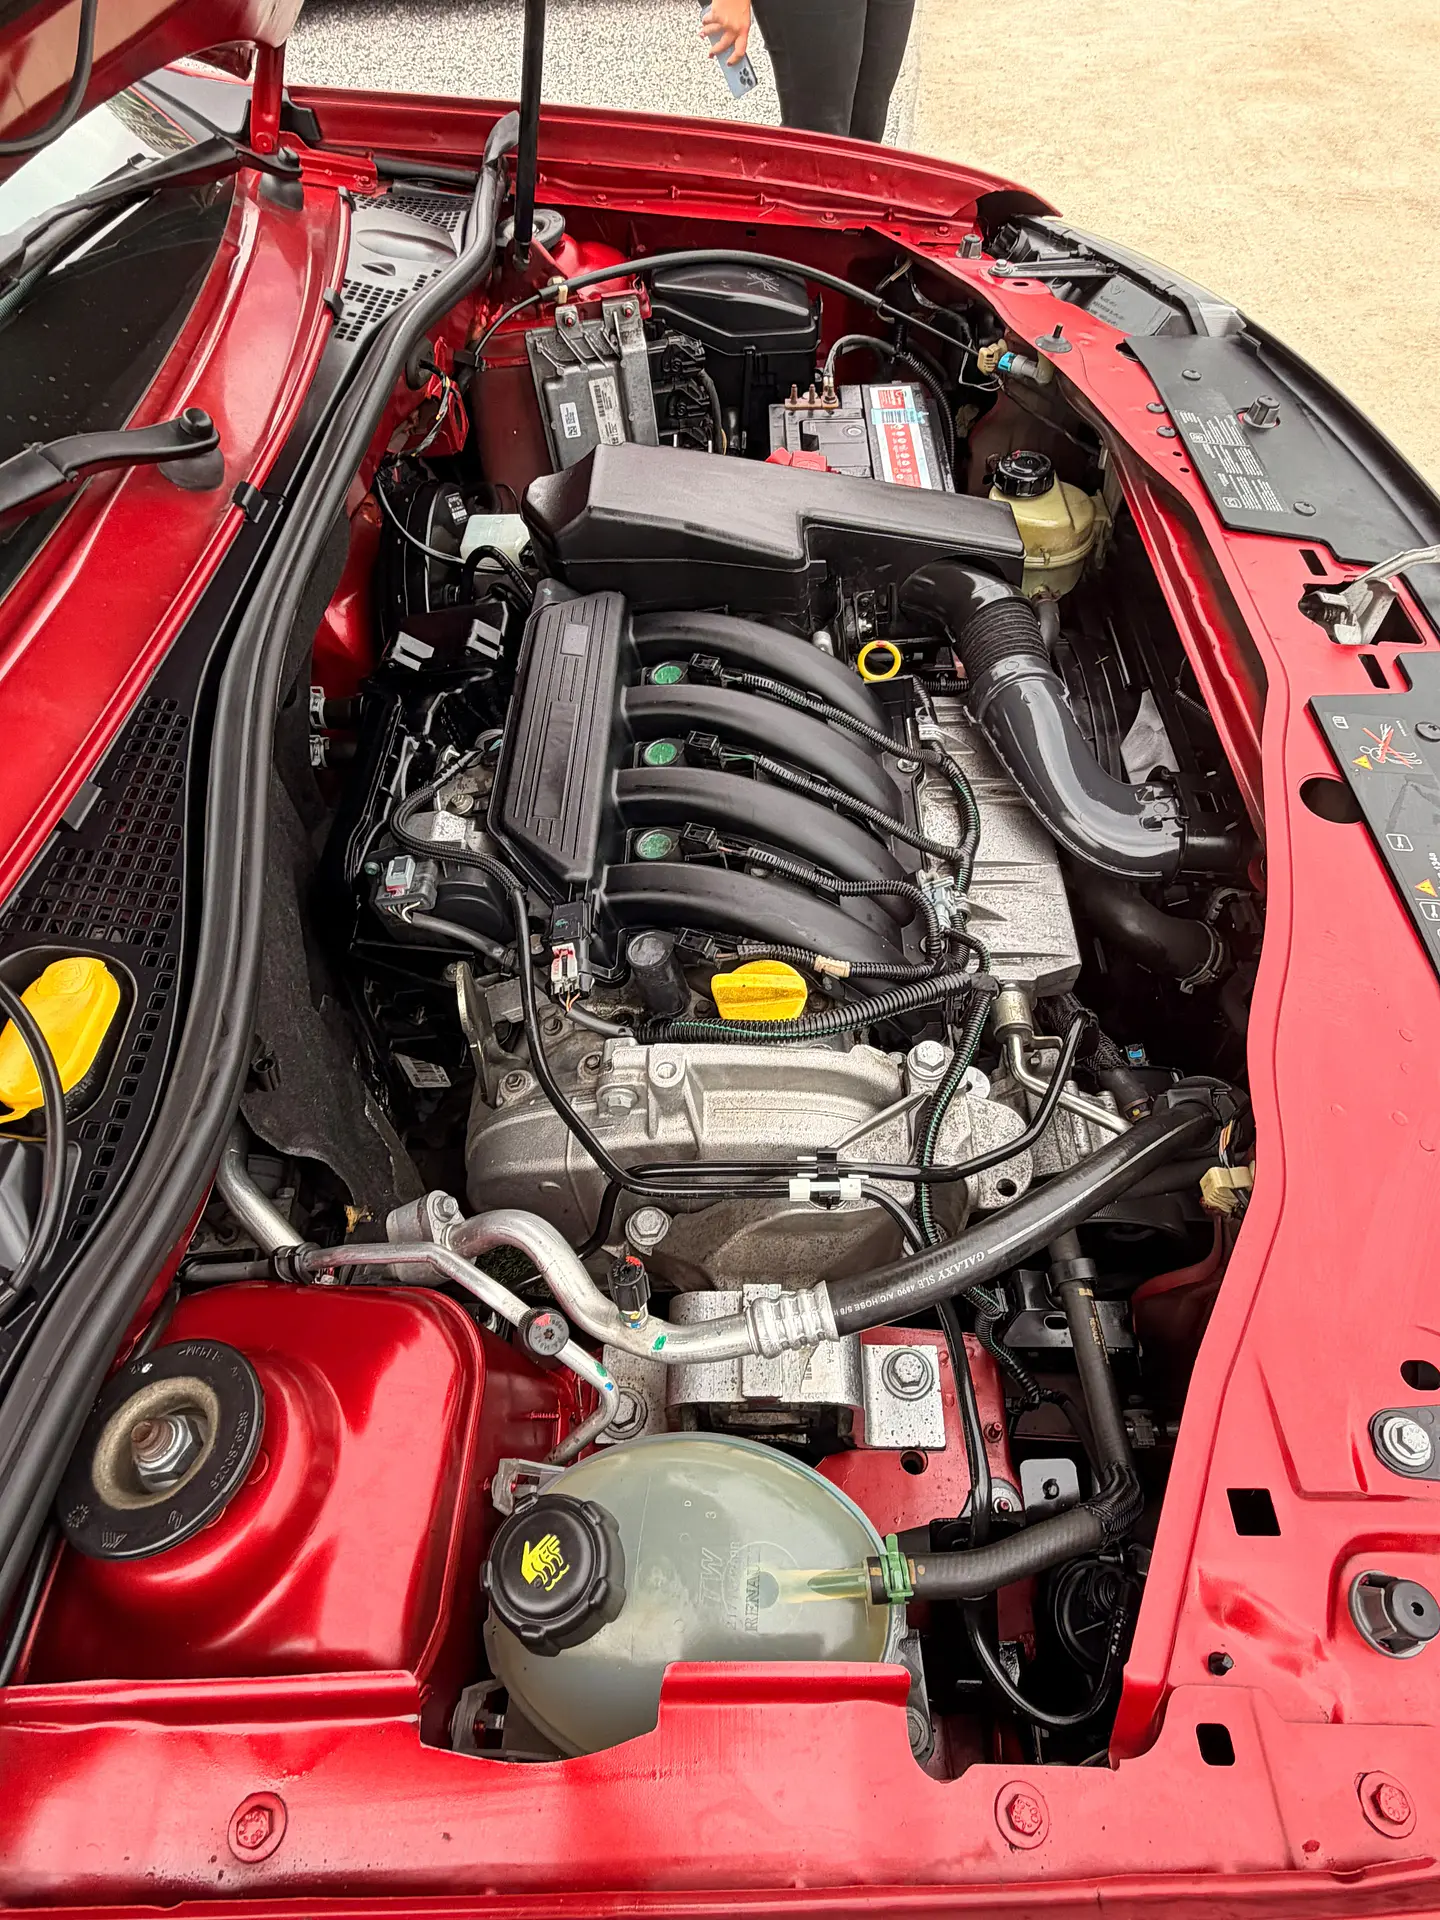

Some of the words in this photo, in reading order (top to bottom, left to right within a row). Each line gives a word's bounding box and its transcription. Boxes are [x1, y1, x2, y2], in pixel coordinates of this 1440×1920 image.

[937, 1251, 985, 1282] GALAXY
[918, 1277, 937, 1290] SLE
[880, 1291, 894, 1304] A/C
[839, 1305, 853, 1317] 5/8
[855, 1299, 879, 1312] HOSE
